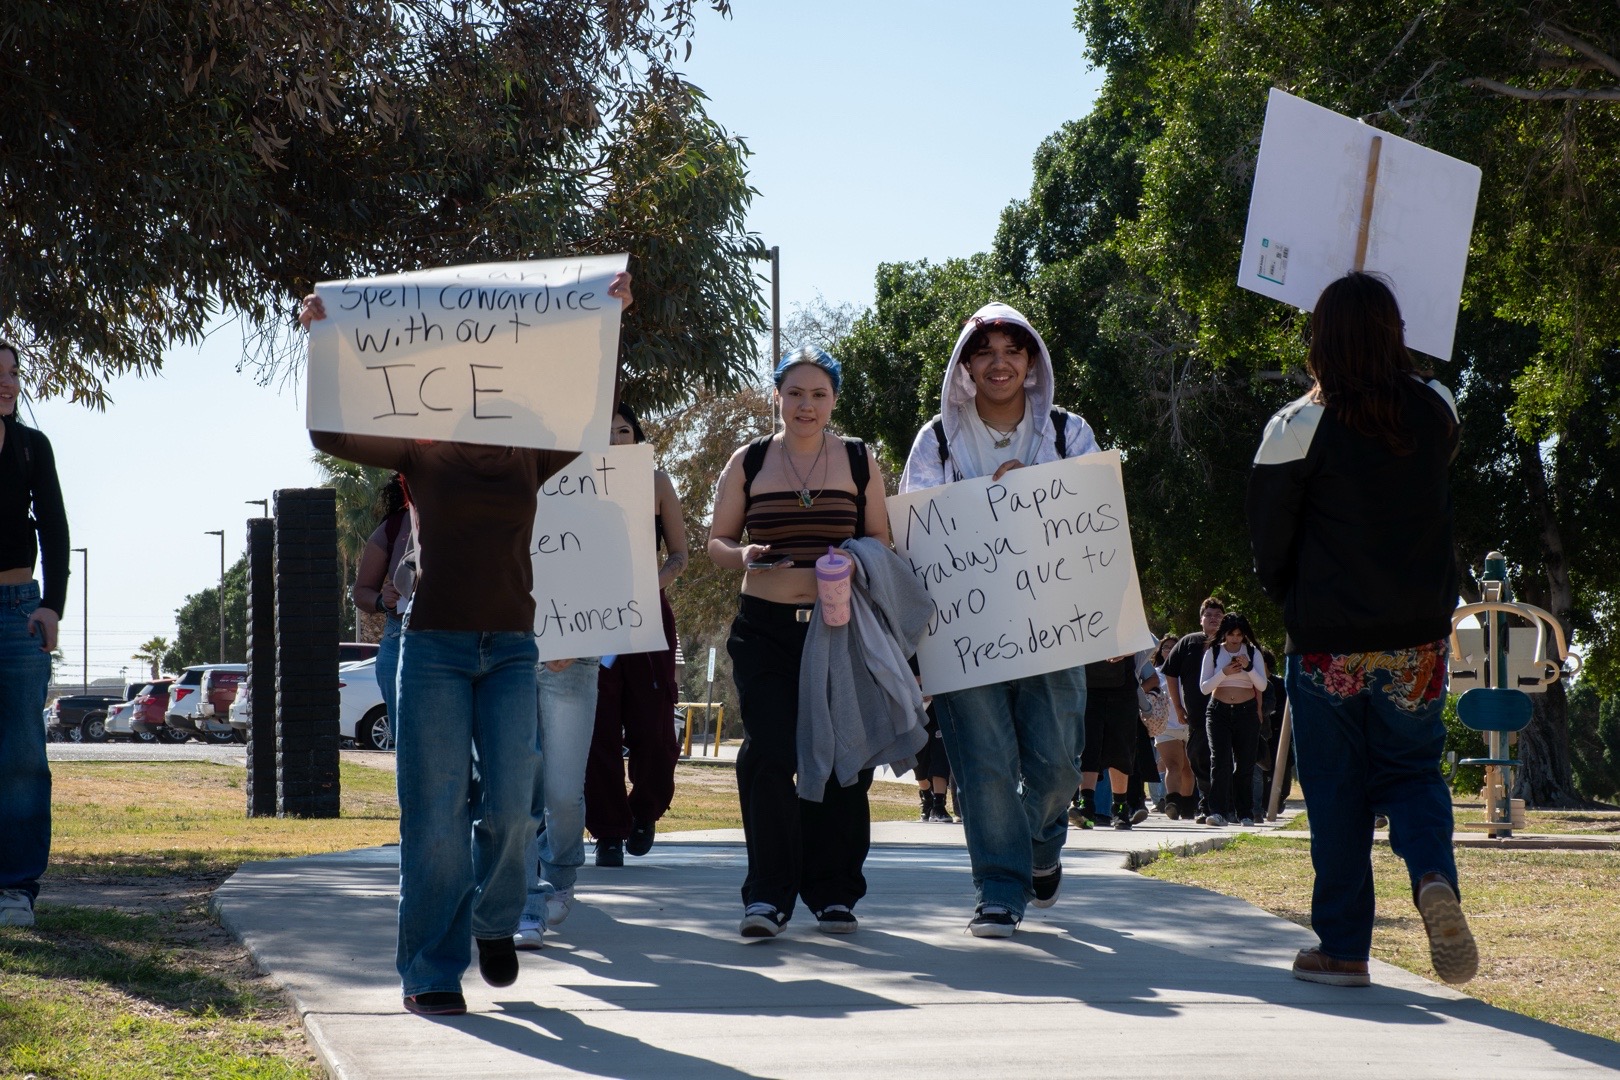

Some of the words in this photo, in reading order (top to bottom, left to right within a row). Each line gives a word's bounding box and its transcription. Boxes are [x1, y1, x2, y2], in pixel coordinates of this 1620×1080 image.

[339, 281, 421, 319] Spell
[365, 363, 513, 419] ICE
[906, 496, 957, 551] Mi
[986, 478, 1078, 522] Papa
[530, 531, 582, 556] en
[909, 531, 1027, 591] trabaja
[1042, 503, 1121, 546] mas
[1016, 557, 1073, 601] que
[1082, 546, 1116, 574] tu
[953, 604, 1110, 674] Presidente
